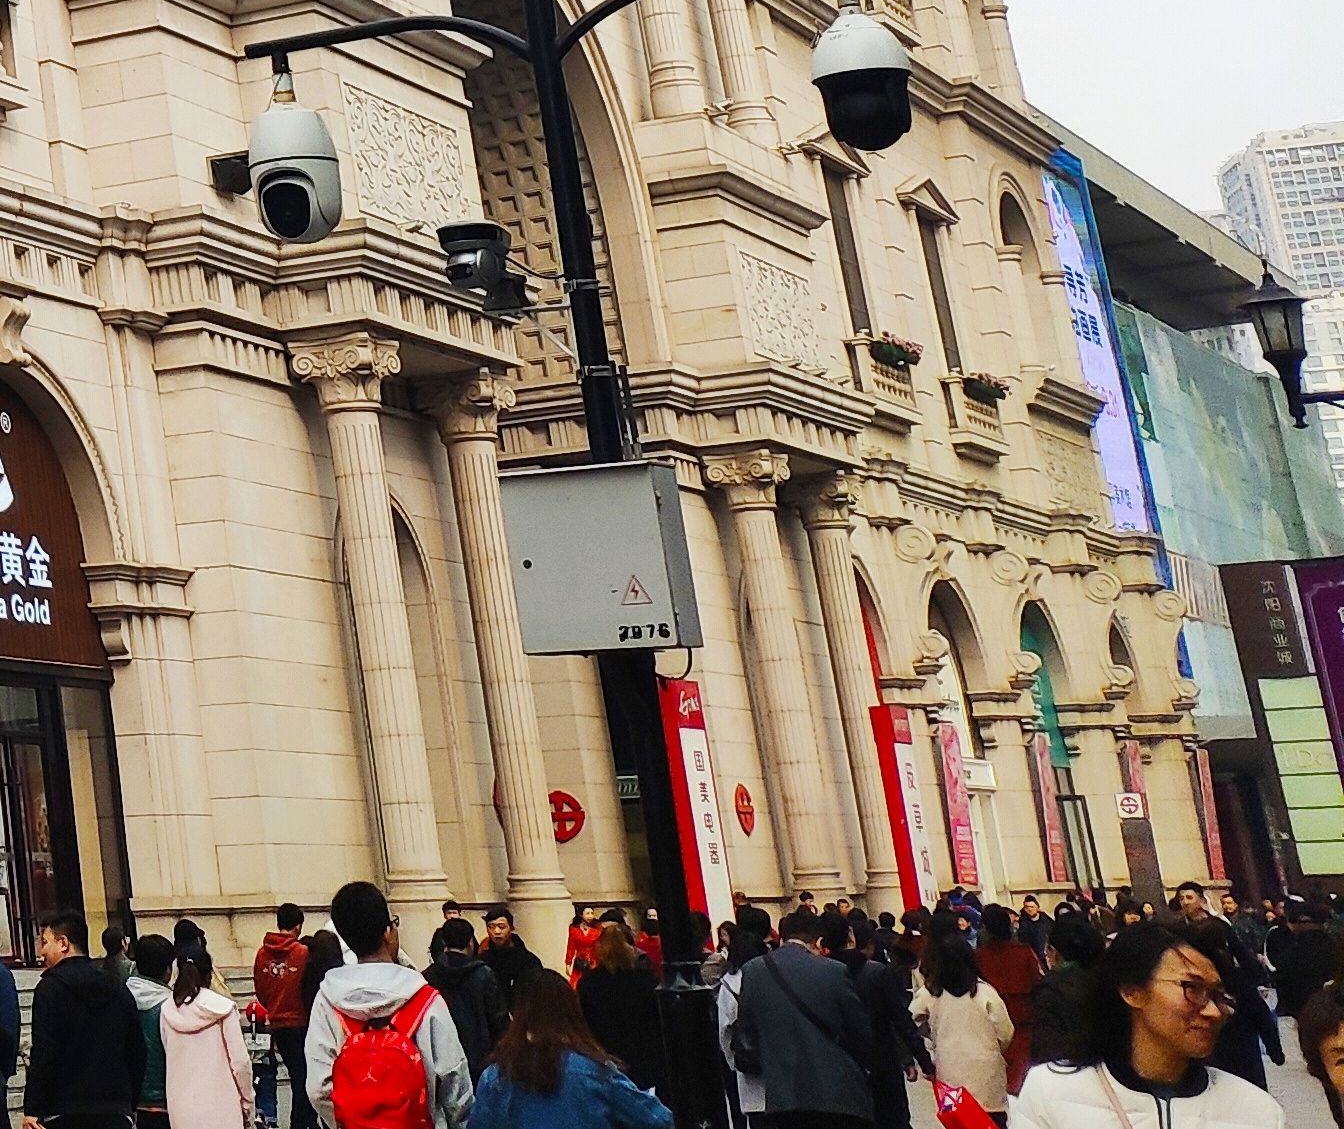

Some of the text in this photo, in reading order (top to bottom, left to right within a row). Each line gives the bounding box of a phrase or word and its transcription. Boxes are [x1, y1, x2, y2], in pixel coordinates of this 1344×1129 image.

[11, 593, 52, 626] Gold
[693, 750, 721, 865] 国美电器
